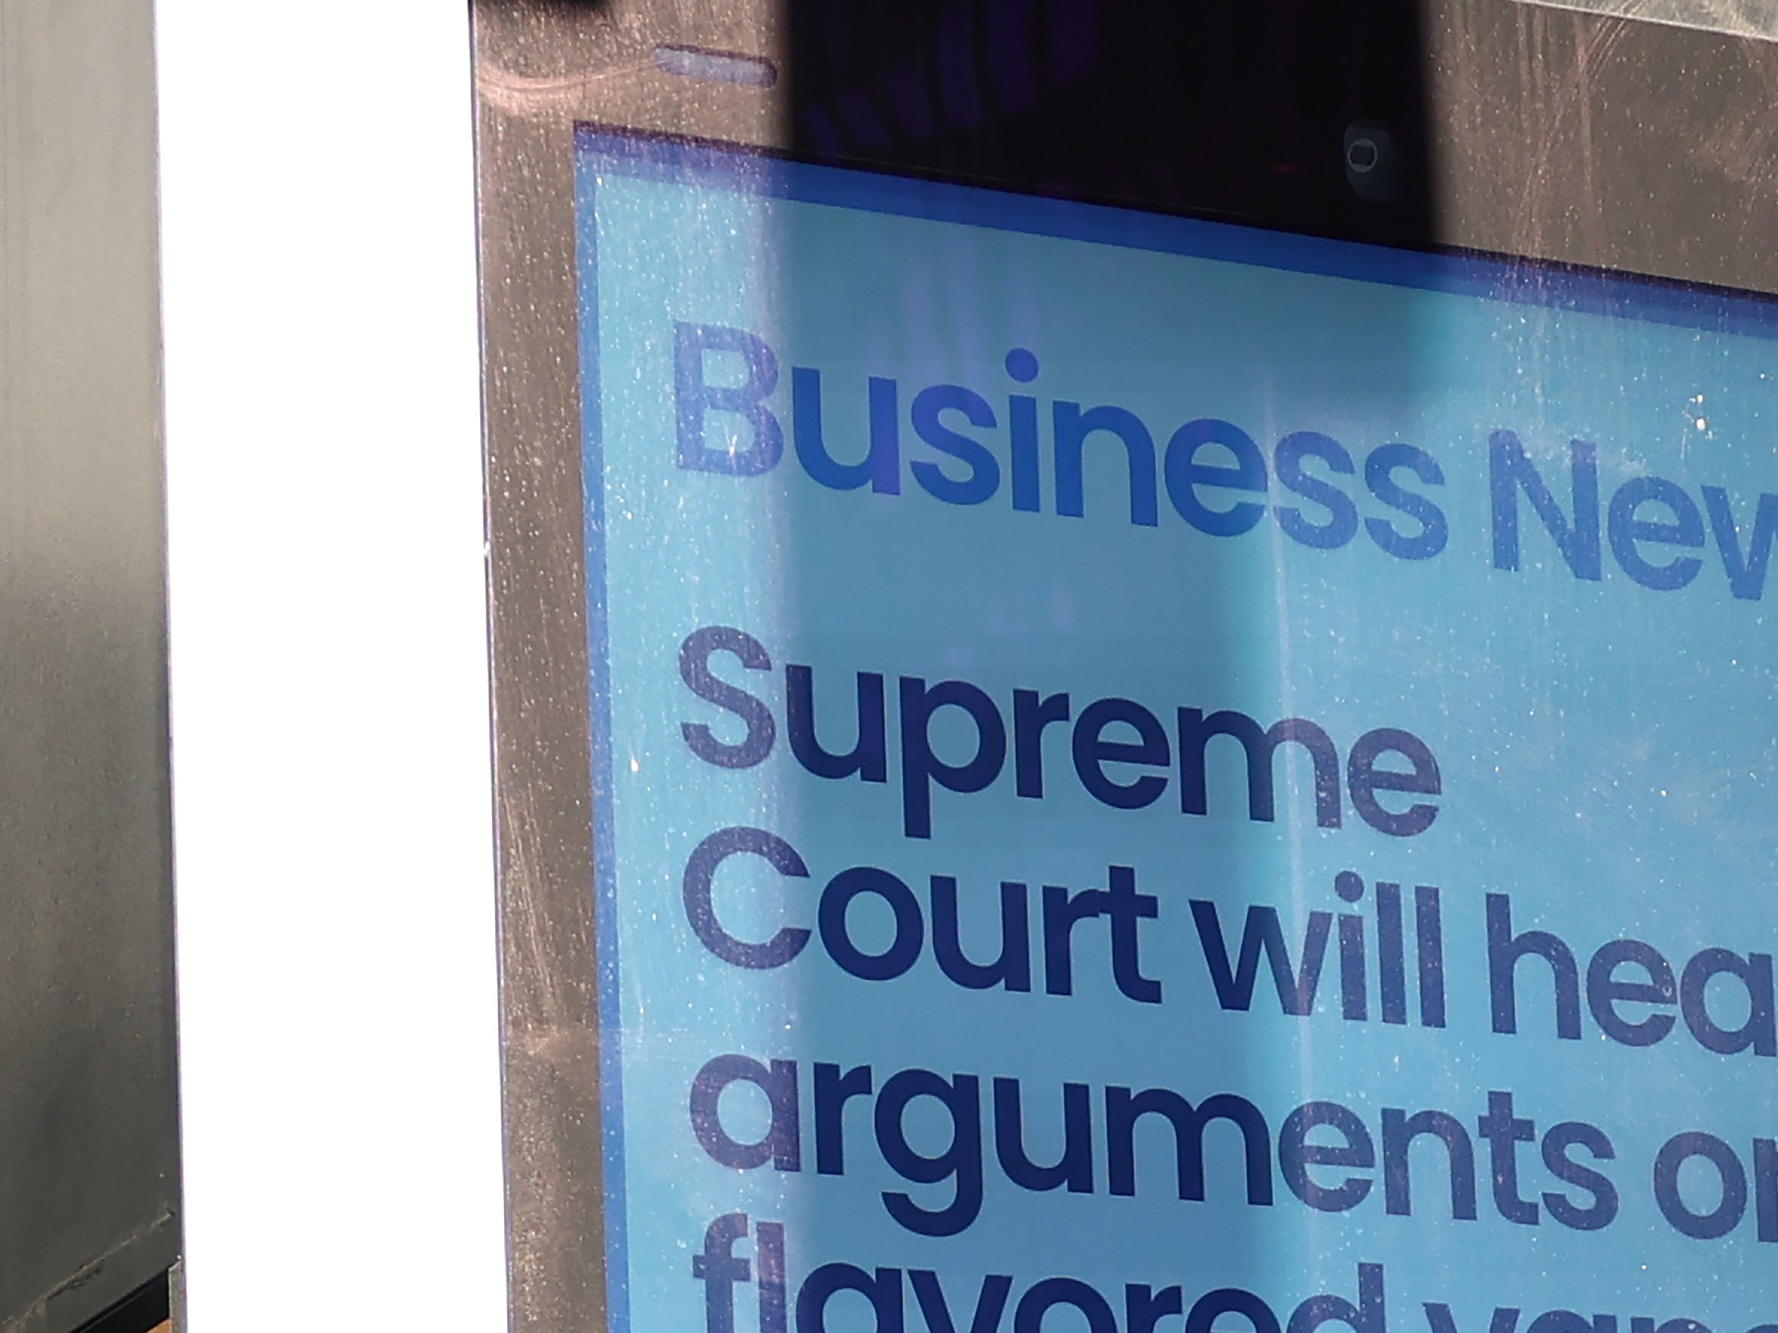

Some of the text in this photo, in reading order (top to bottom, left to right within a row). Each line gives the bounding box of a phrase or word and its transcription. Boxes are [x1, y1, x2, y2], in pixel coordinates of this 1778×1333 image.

[672, 322, 1448, 560] Business
[679, 625, 1442, 839] Supreme
[682, 826, 1162, 1003] Court
[1189, 872, 1445, 1029] will
[690, 1051, 1620, 1238] arguments
